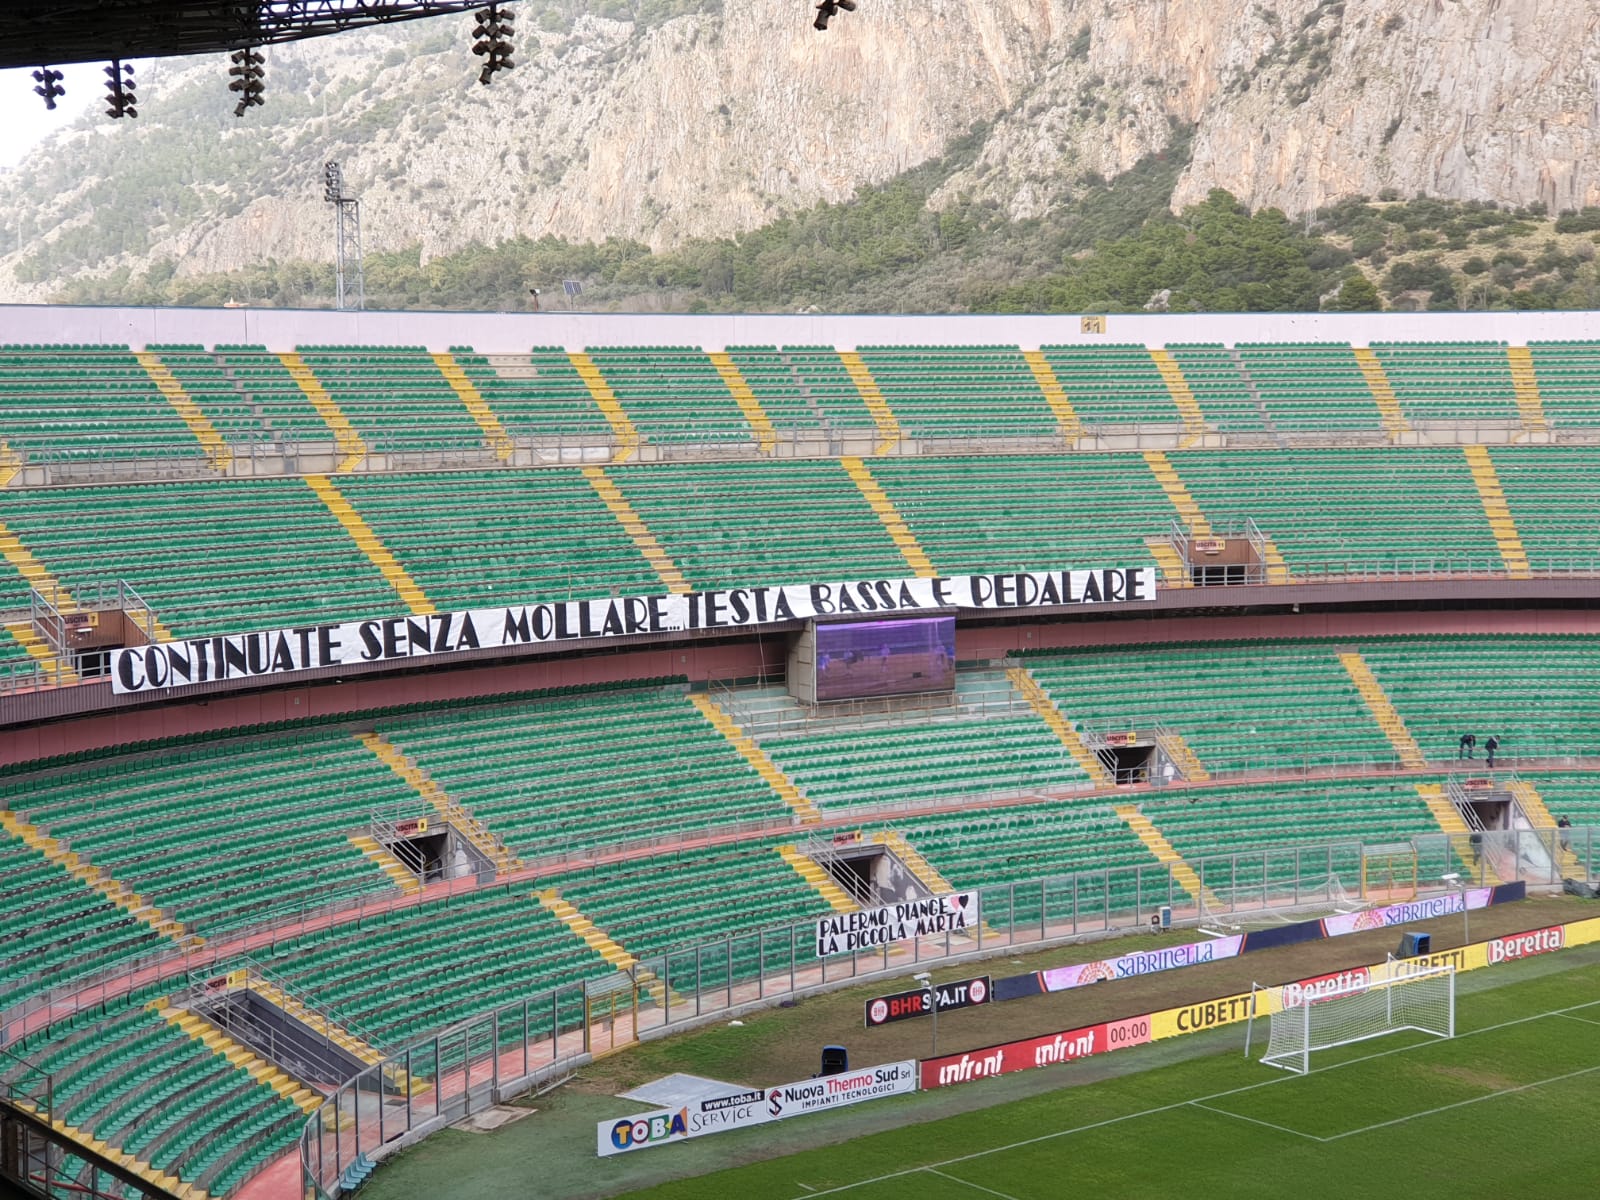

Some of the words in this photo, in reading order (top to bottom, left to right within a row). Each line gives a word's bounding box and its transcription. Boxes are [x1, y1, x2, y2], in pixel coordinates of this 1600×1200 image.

[64, 615, 89, 625] USCITA
[118, 624, 342, 691] CONTINUATE
[359, 611, 481, 661] SENZA
[683, 586, 798, 628] TESTA
[810, 580, 921, 614] BASSA
[931, 577, 957, 606] E
[970, 568, 1146, 606] PEDALARE
[395, 822, 418, 832] USCITA
[820, 908, 888, 937] PALERMO
[896, 896, 948, 922] PIANGE
[818, 938, 839, 956] LA
[847, 923, 907, 950] PICCOLA
[1491, 929, 1561, 964] Beretta
[1287, 970, 1366, 1008] Beretta
[1177, 994, 1257, 1031] CUBETTI
[1110, 1022, 1147, 1044] 00:00
[704, 1091, 762, 1111] www.toba.it
[784, 1084, 824, 1103] Nuova
[826, 1074, 873, 1094] Thermo
[875, 1066, 899, 1084] Sud
[901, 1070, 910, 1079] Srl
[802, 1096, 839, 1109] IMPIANTI
[842, 1083, 895, 1099] TECNOLOGICI
[613, 1109, 688, 1147] TOBA
